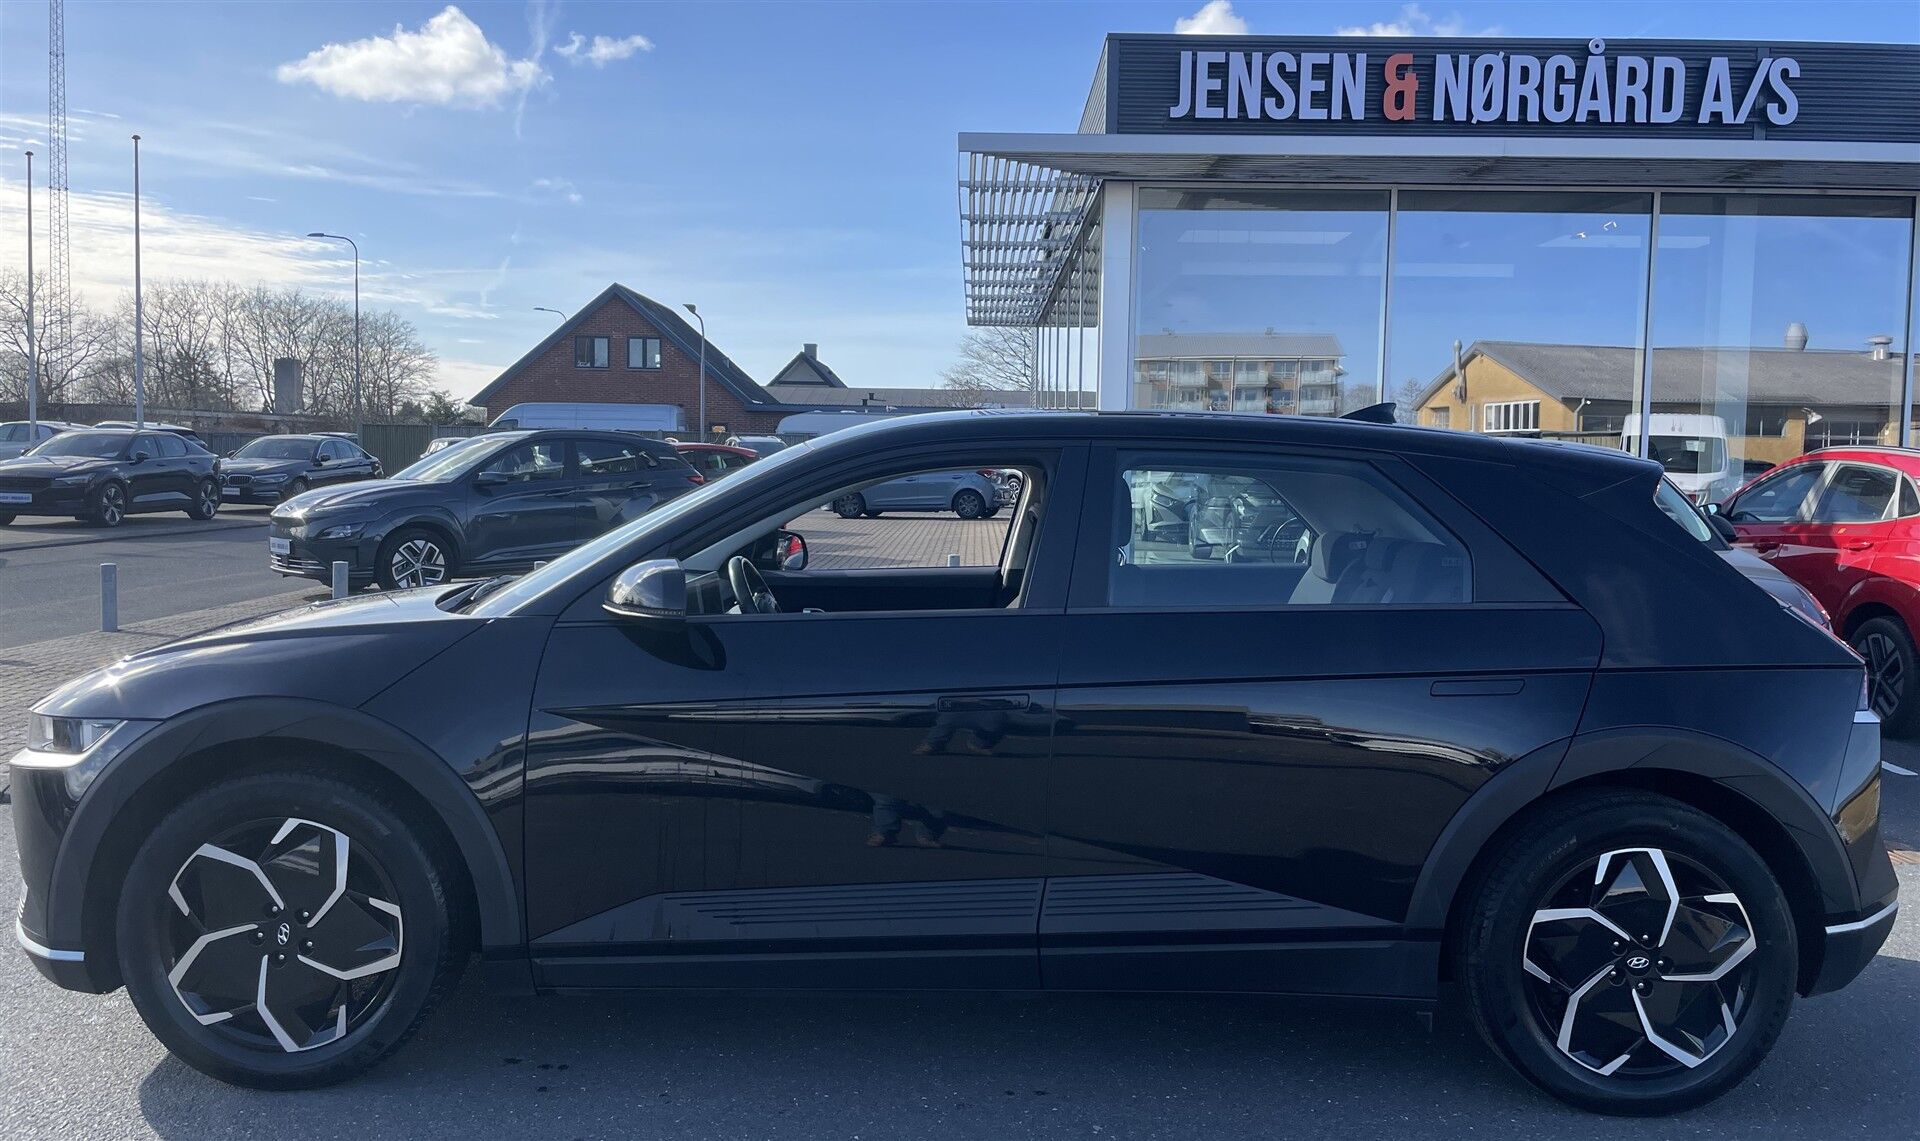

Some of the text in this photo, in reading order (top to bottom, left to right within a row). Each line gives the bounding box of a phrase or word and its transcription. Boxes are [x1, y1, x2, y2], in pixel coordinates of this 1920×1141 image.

[1170, 38, 1801, 126] JENSEN & NØRGÅRD A/S
